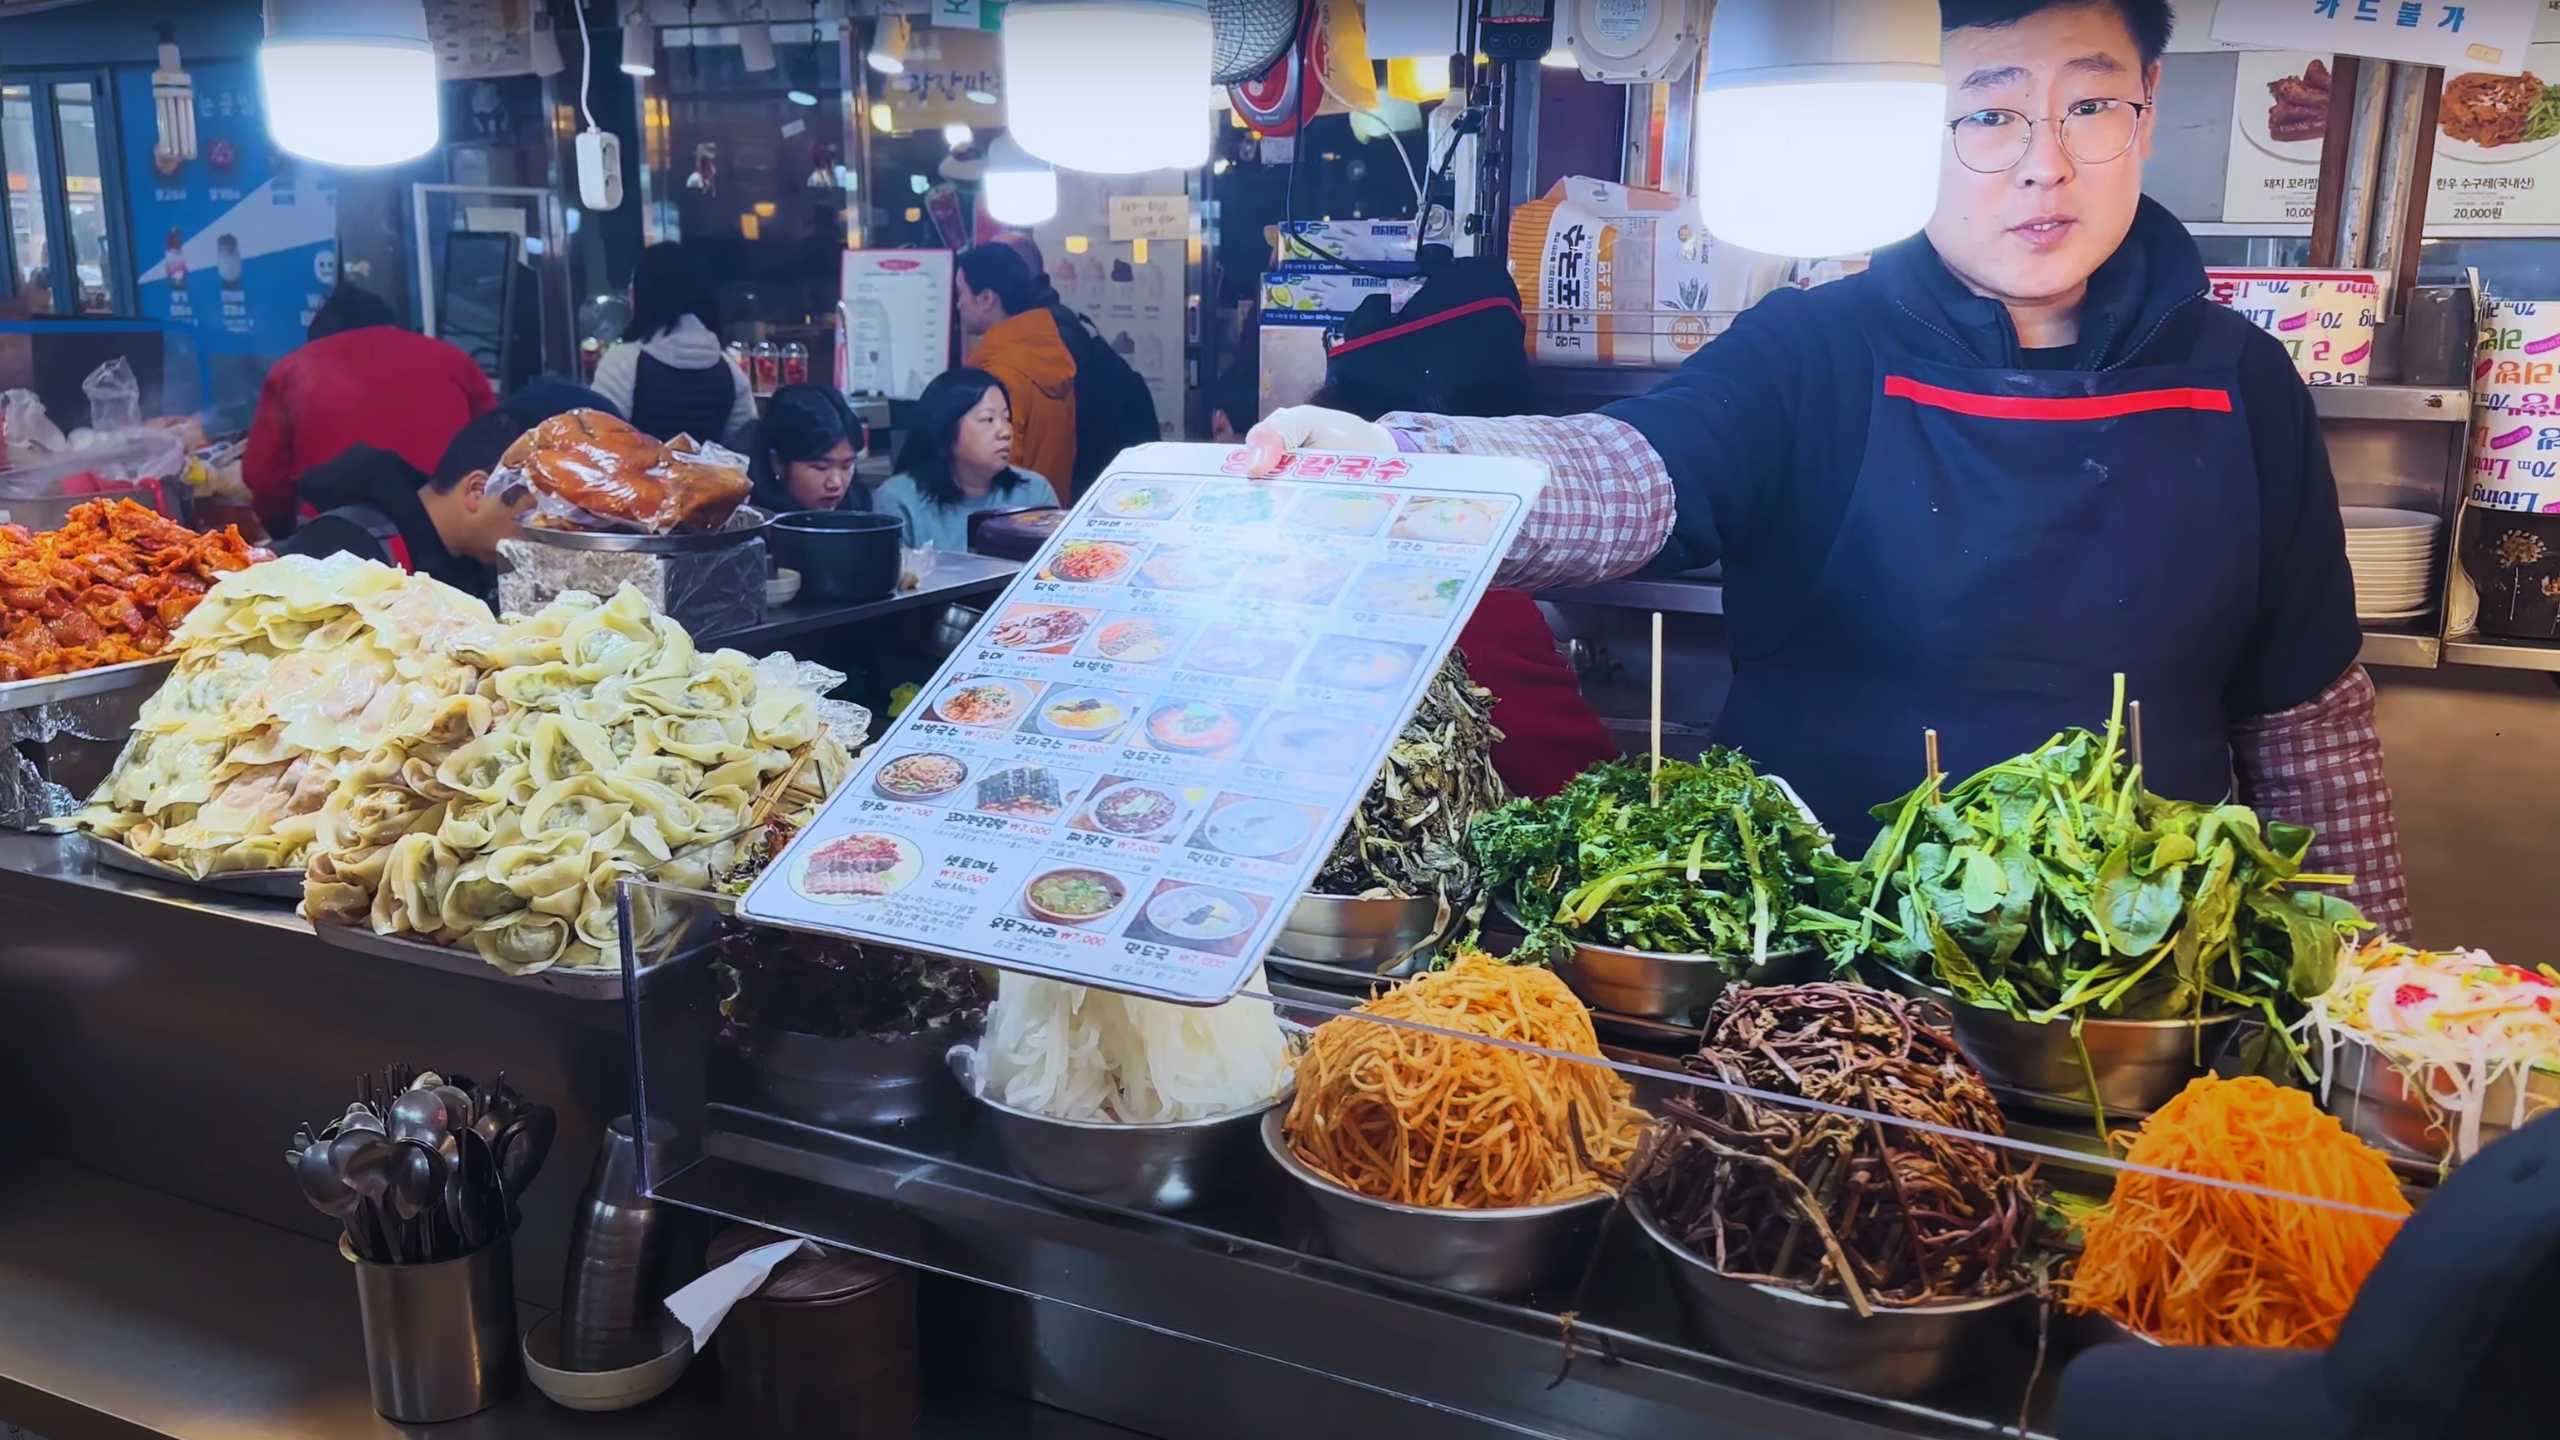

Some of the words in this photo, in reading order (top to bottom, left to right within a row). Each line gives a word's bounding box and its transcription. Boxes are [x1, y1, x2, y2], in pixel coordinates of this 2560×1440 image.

[2264, 178, 2284, 189] 돼지
[2436, 178, 2457, 190] 한우
[2460, 177, 2534, 190] 수구레(국내산)
[2453, 207, 2502, 219] 20,000원
[1557, 224, 1586, 333] 구포국수
[2494, 361, 2553, 385] 리빙
[2518, 460, 2556, 478] 70m
[2472, 484, 2540, 513] Living
[910, 722, 960, 737] 비빔국수
[1013, 734, 1064, 750] 잔치국수
[938, 868, 990, 885] ₩15,000
[1059, 932, 1106, 947] ₩7,000
[1124, 941, 1171, 961] 만두국
